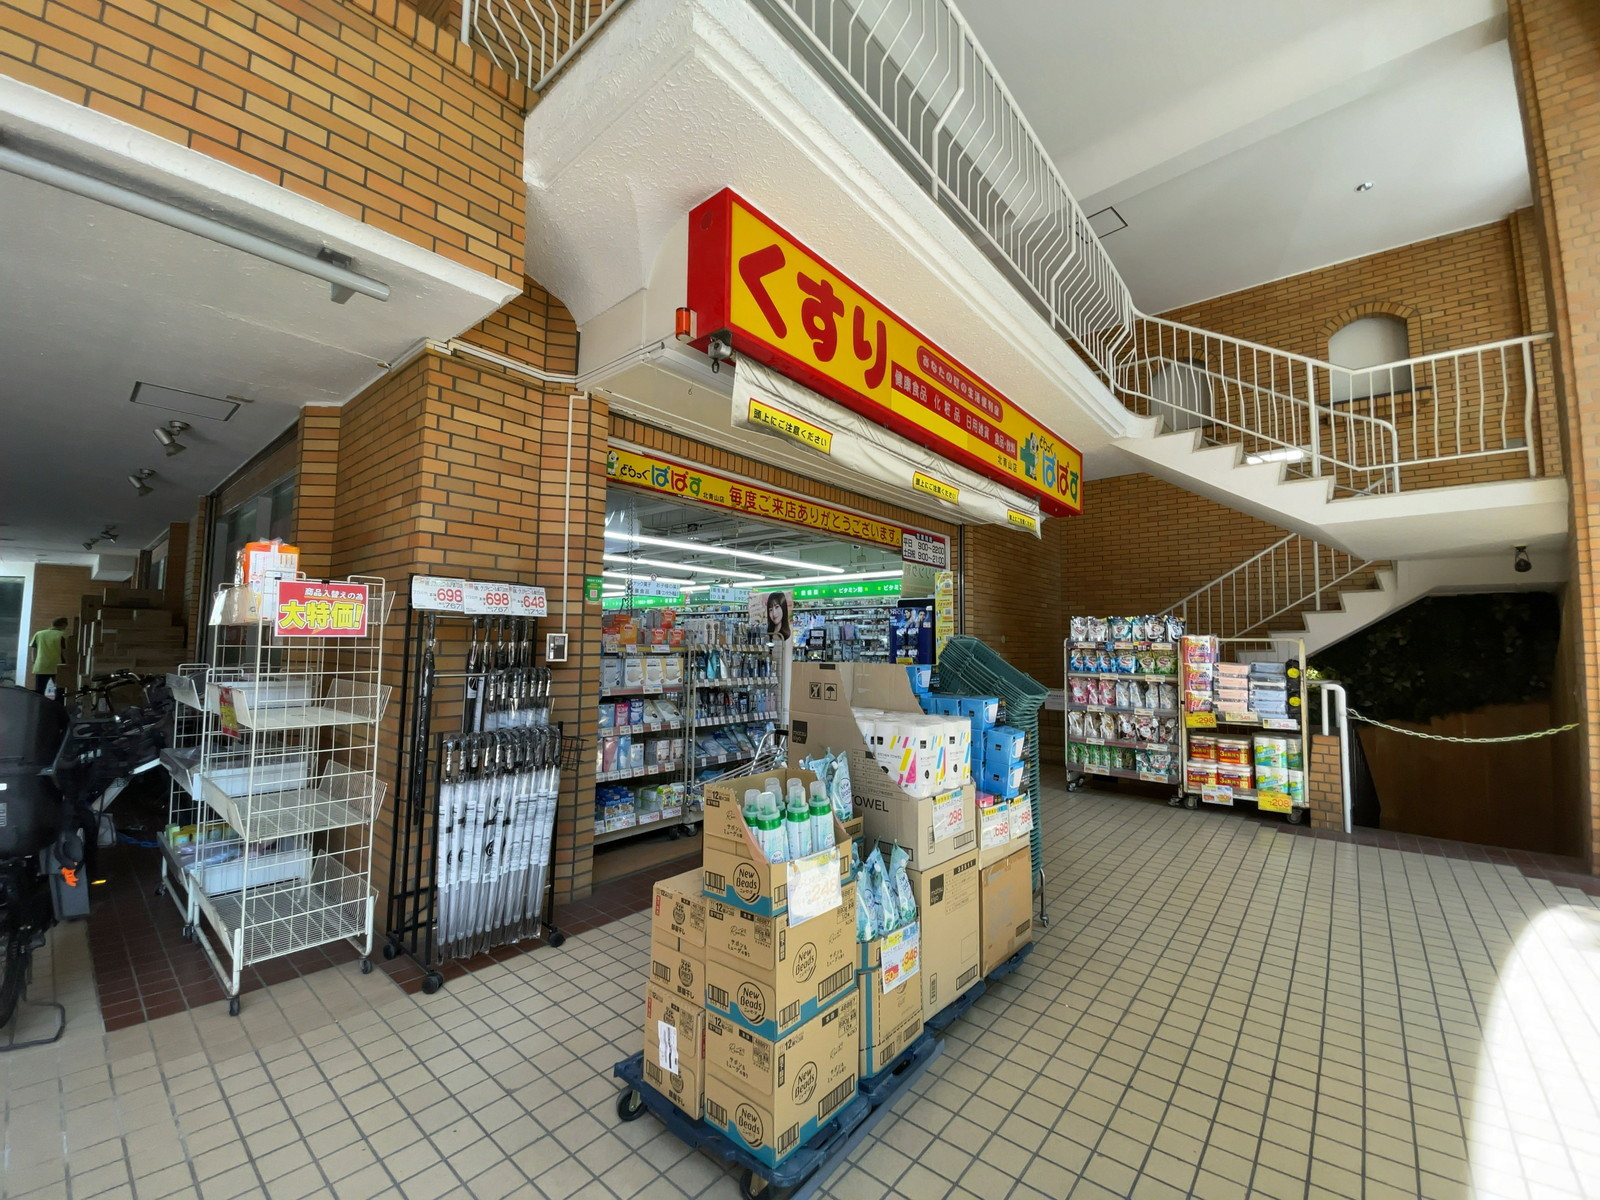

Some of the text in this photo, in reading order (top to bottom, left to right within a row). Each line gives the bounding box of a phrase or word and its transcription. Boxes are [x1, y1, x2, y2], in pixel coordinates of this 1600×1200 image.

[738, 243, 888, 390] くすり
[894, 369, 928, 403] 健康食品
[934, 393, 961, 423] 化粧品
[966, 415, 990, 440] 日用雑貨
[753, 408, 827, 447] 頭上にご注意ください
[997, 455, 1018, 473] 北青山店
[651, 464, 702, 496] ぱぱす
[1042, 450, 1079, 504] ぱぱす
[915, 477, 956, 501] 頭上にご注意ください
[702, 491, 725, 504] 北青山店
[729, 485, 900, 544] 毎度ご来店ありがとうございます。
[903, 537, 912, 548] 平日
[304, 587, 363, 601] 商品入替えの為
[437, 587, 463, 603] 698
[486, 592, 509, 606] 698
[523, 595, 545, 608] 648
[279, 600, 365, 630] 大特価!
[1272, 799, 1290, 808] 208
[948, 808, 962, 826] 298
[994, 822, 1009, 837] 698
[739, 868, 755, 879] New
[736, 877, 757, 889] Beads
[798, 948, 813, 964] New
[795, 955, 815, 975] Beads
[743, 987, 760, 999] New
[740, 996, 762, 1011] Beads
[797, 1067, 812, 1084] New
[795, 1073, 815, 1098] Beads
[741, 1108, 758, 1123] New
[738, 1116, 760, 1135] Beads
